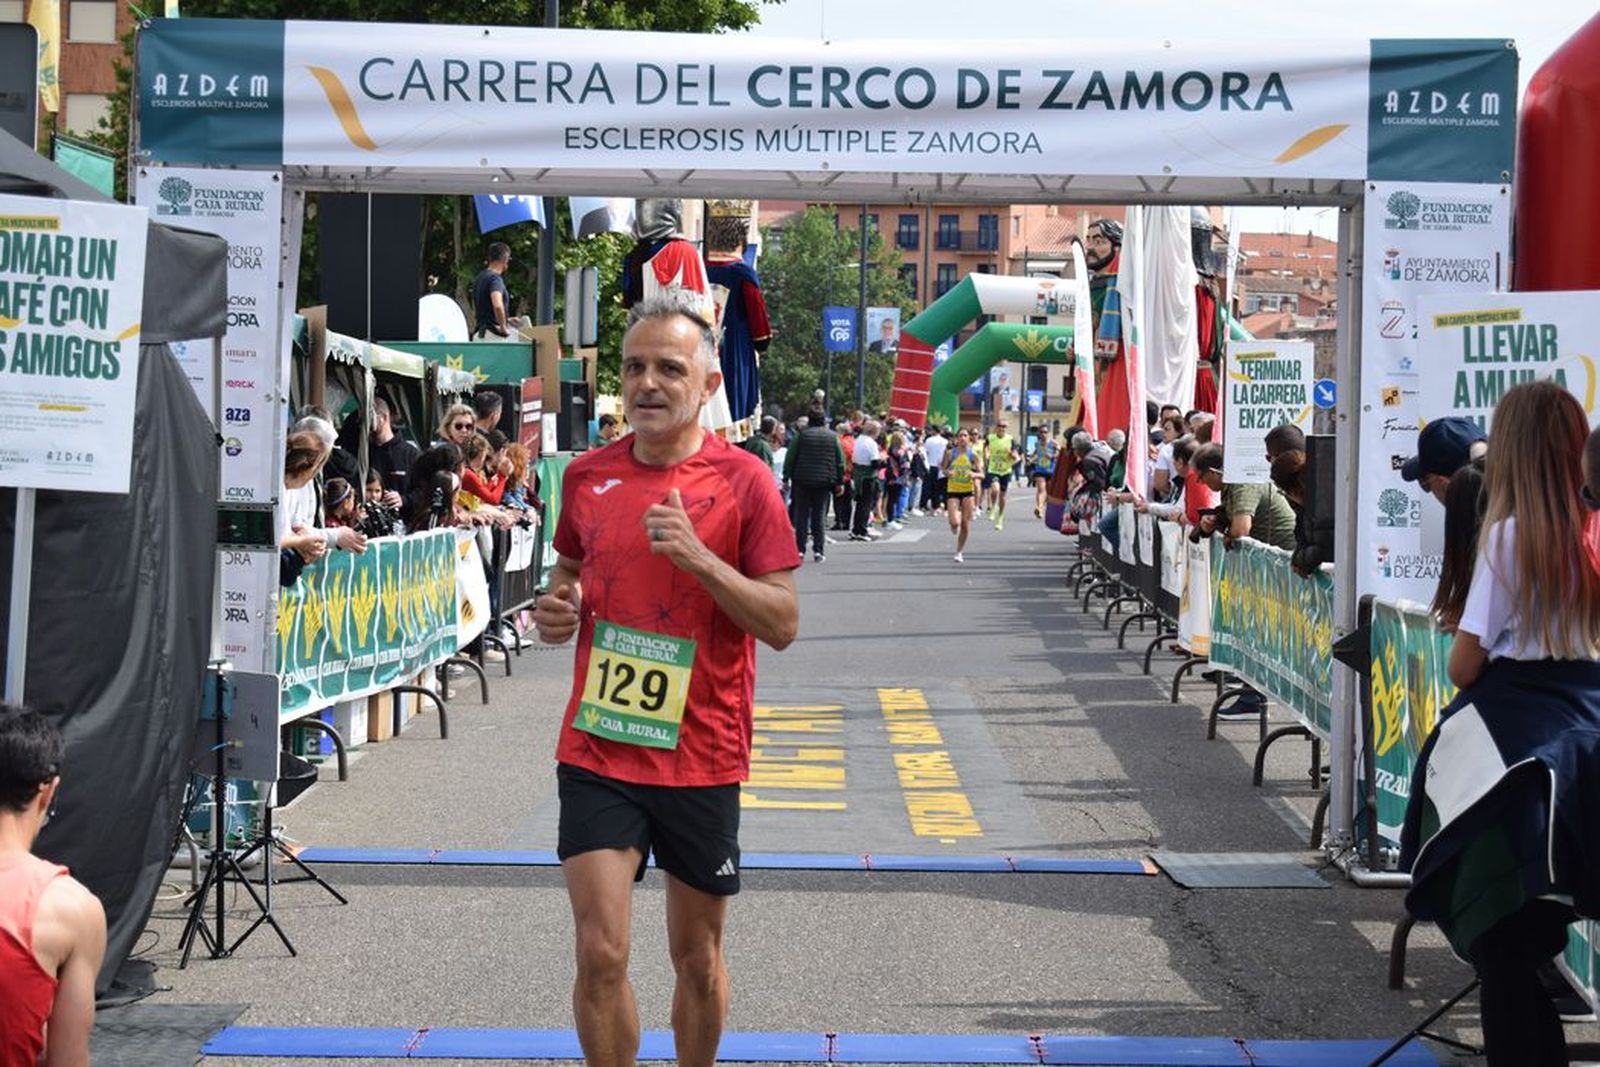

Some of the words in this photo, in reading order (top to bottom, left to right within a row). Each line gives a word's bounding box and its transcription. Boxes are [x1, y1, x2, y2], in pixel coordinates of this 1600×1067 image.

[358, 57, 616, 105] CARRERA
[635, 62, 731, 107] DEL
[746, 64, 936, 110] CERCO
[956, 68, 1022, 110] DE
[1037, 69, 1294, 112] ZAMORA
[151, 99, 196, 108] ESCLEROSIS
[235, 100, 269, 109] ZAMORA
[1382, 116, 1427, 125] ESCLEROSIS
[1465, 118, 1500, 127] ZAMORA
[564, 126, 744, 152] ESCLEROSIS
[755, 123, 897, 153] MÚLTIPLE
[907, 130, 1043, 155] ZAMORA
[194, 188, 264, 201] FUNDACION
[223, 201, 264, 212] RURAL
[1421, 202, 1493, 214] FUNDACION
[1452, 213, 1493, 225] RURAL
[77, 236, 118, 281] UN
[1404, 257, 1491, 270] AYUNTAMIENTO
[1404, 267, 1423, 281] DE
[1426, 268, 1491, 283] ZAMORA
[49, 284, 109, 331] CON
[830, 319, 851, 327] VOTA
[1463, 323, 1559, 364] LLEVAR
[10, 331, 122, 381] AMIGOS
[1239, 359, 1302, 381] TERMINAR
[1233, 383, 1248, 405] LA
[1250, 383, 1307, 405] CARRERA
[1454, 370, 1471, 408] A
[1239, 407, 1255, 429] EN
[1394, 565, 1412, 578] DE
[617, 629, 680, 654] FUNDACION
[640, 646, 677, 663] RURAL
[598, 657, 669, 712] 129
[627, 722, 671, 741] RURAL
